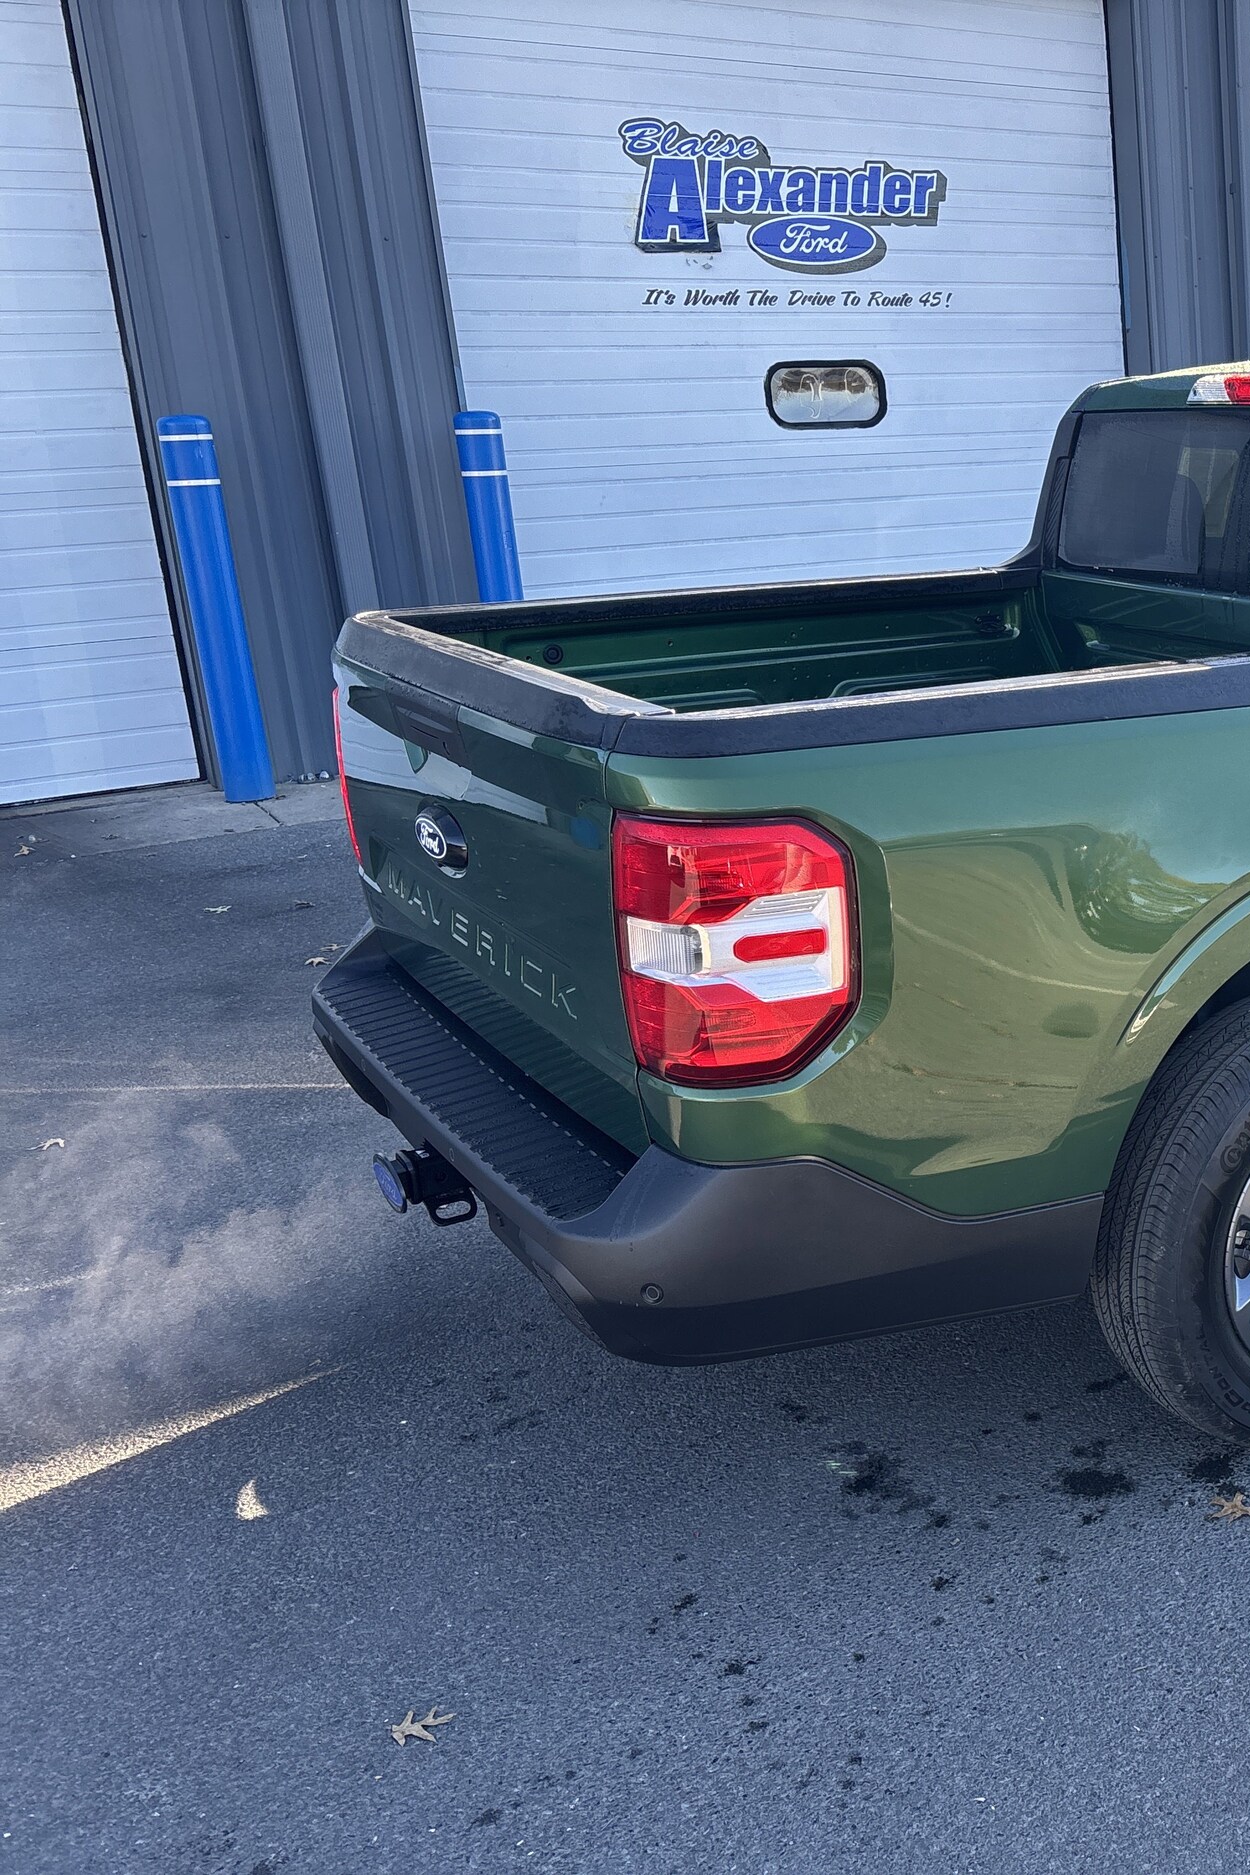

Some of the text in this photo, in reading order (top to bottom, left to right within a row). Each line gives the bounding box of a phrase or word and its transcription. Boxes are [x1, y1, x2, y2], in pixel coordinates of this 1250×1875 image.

[621, 120, 759, 159] Blaise
[639, 155, 940, 243] Alexander
[779, 222, 848, 255] Ford
[642, 289, 675, 307] It's
[684, 289, 741, 308] Worth
[747, 290, 779, 308] The
[787, 290, 835, 308] Drive
[841, 291, 861, 308] To
[867, 291, 913, 309] Route
[420, 821, 440, 855] Ford
[388, 861, 578, 1020] MAVERICK
